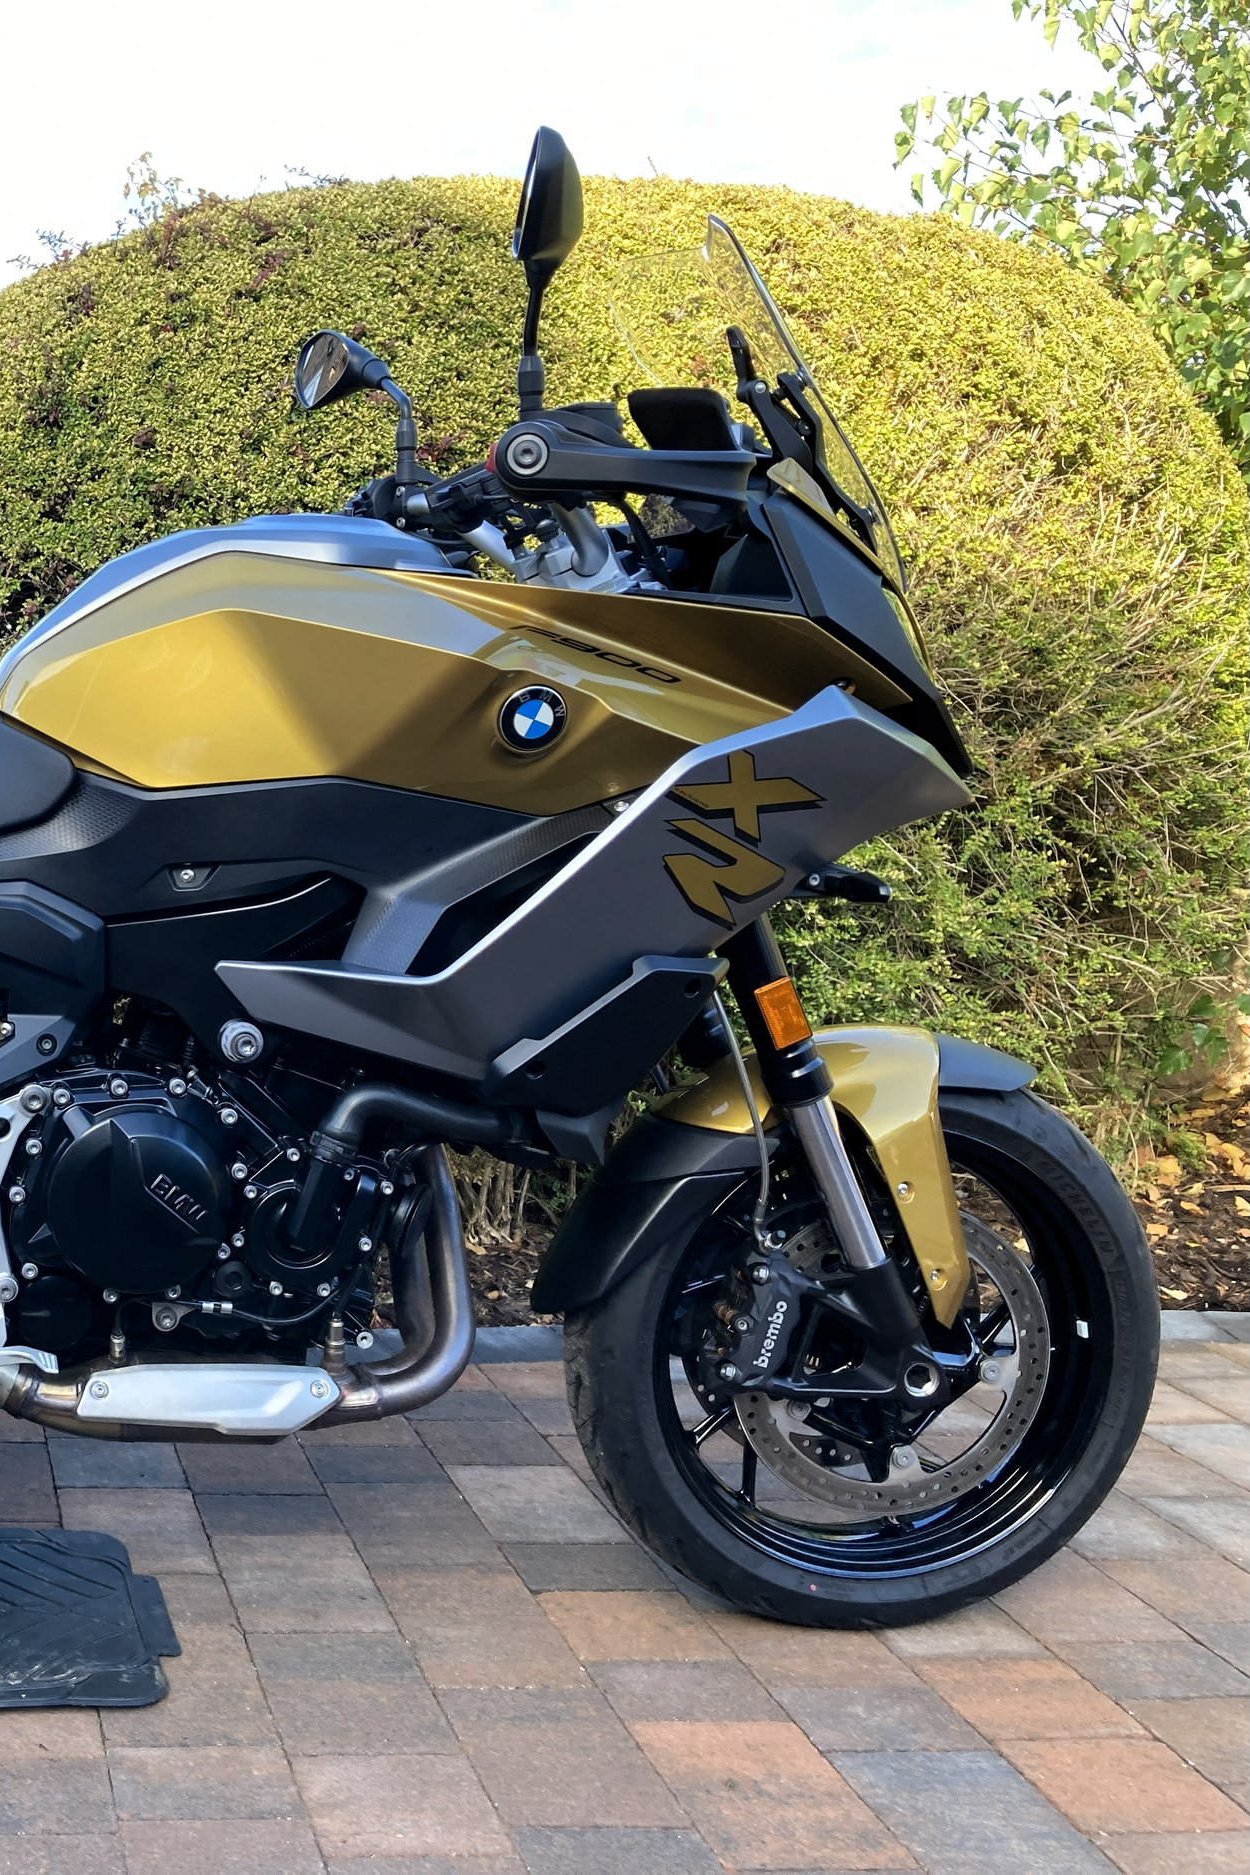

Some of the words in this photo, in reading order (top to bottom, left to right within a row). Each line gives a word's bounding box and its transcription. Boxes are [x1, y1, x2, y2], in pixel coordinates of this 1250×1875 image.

[509, 624, 682, 684] F900
[518, 687, 567, 719] BMW
[150, 1173, 208, 1221] BMW
[1035, 1159, 1116, 1255] MICHELIN
[752, 1300, 788, 1369] brembo
